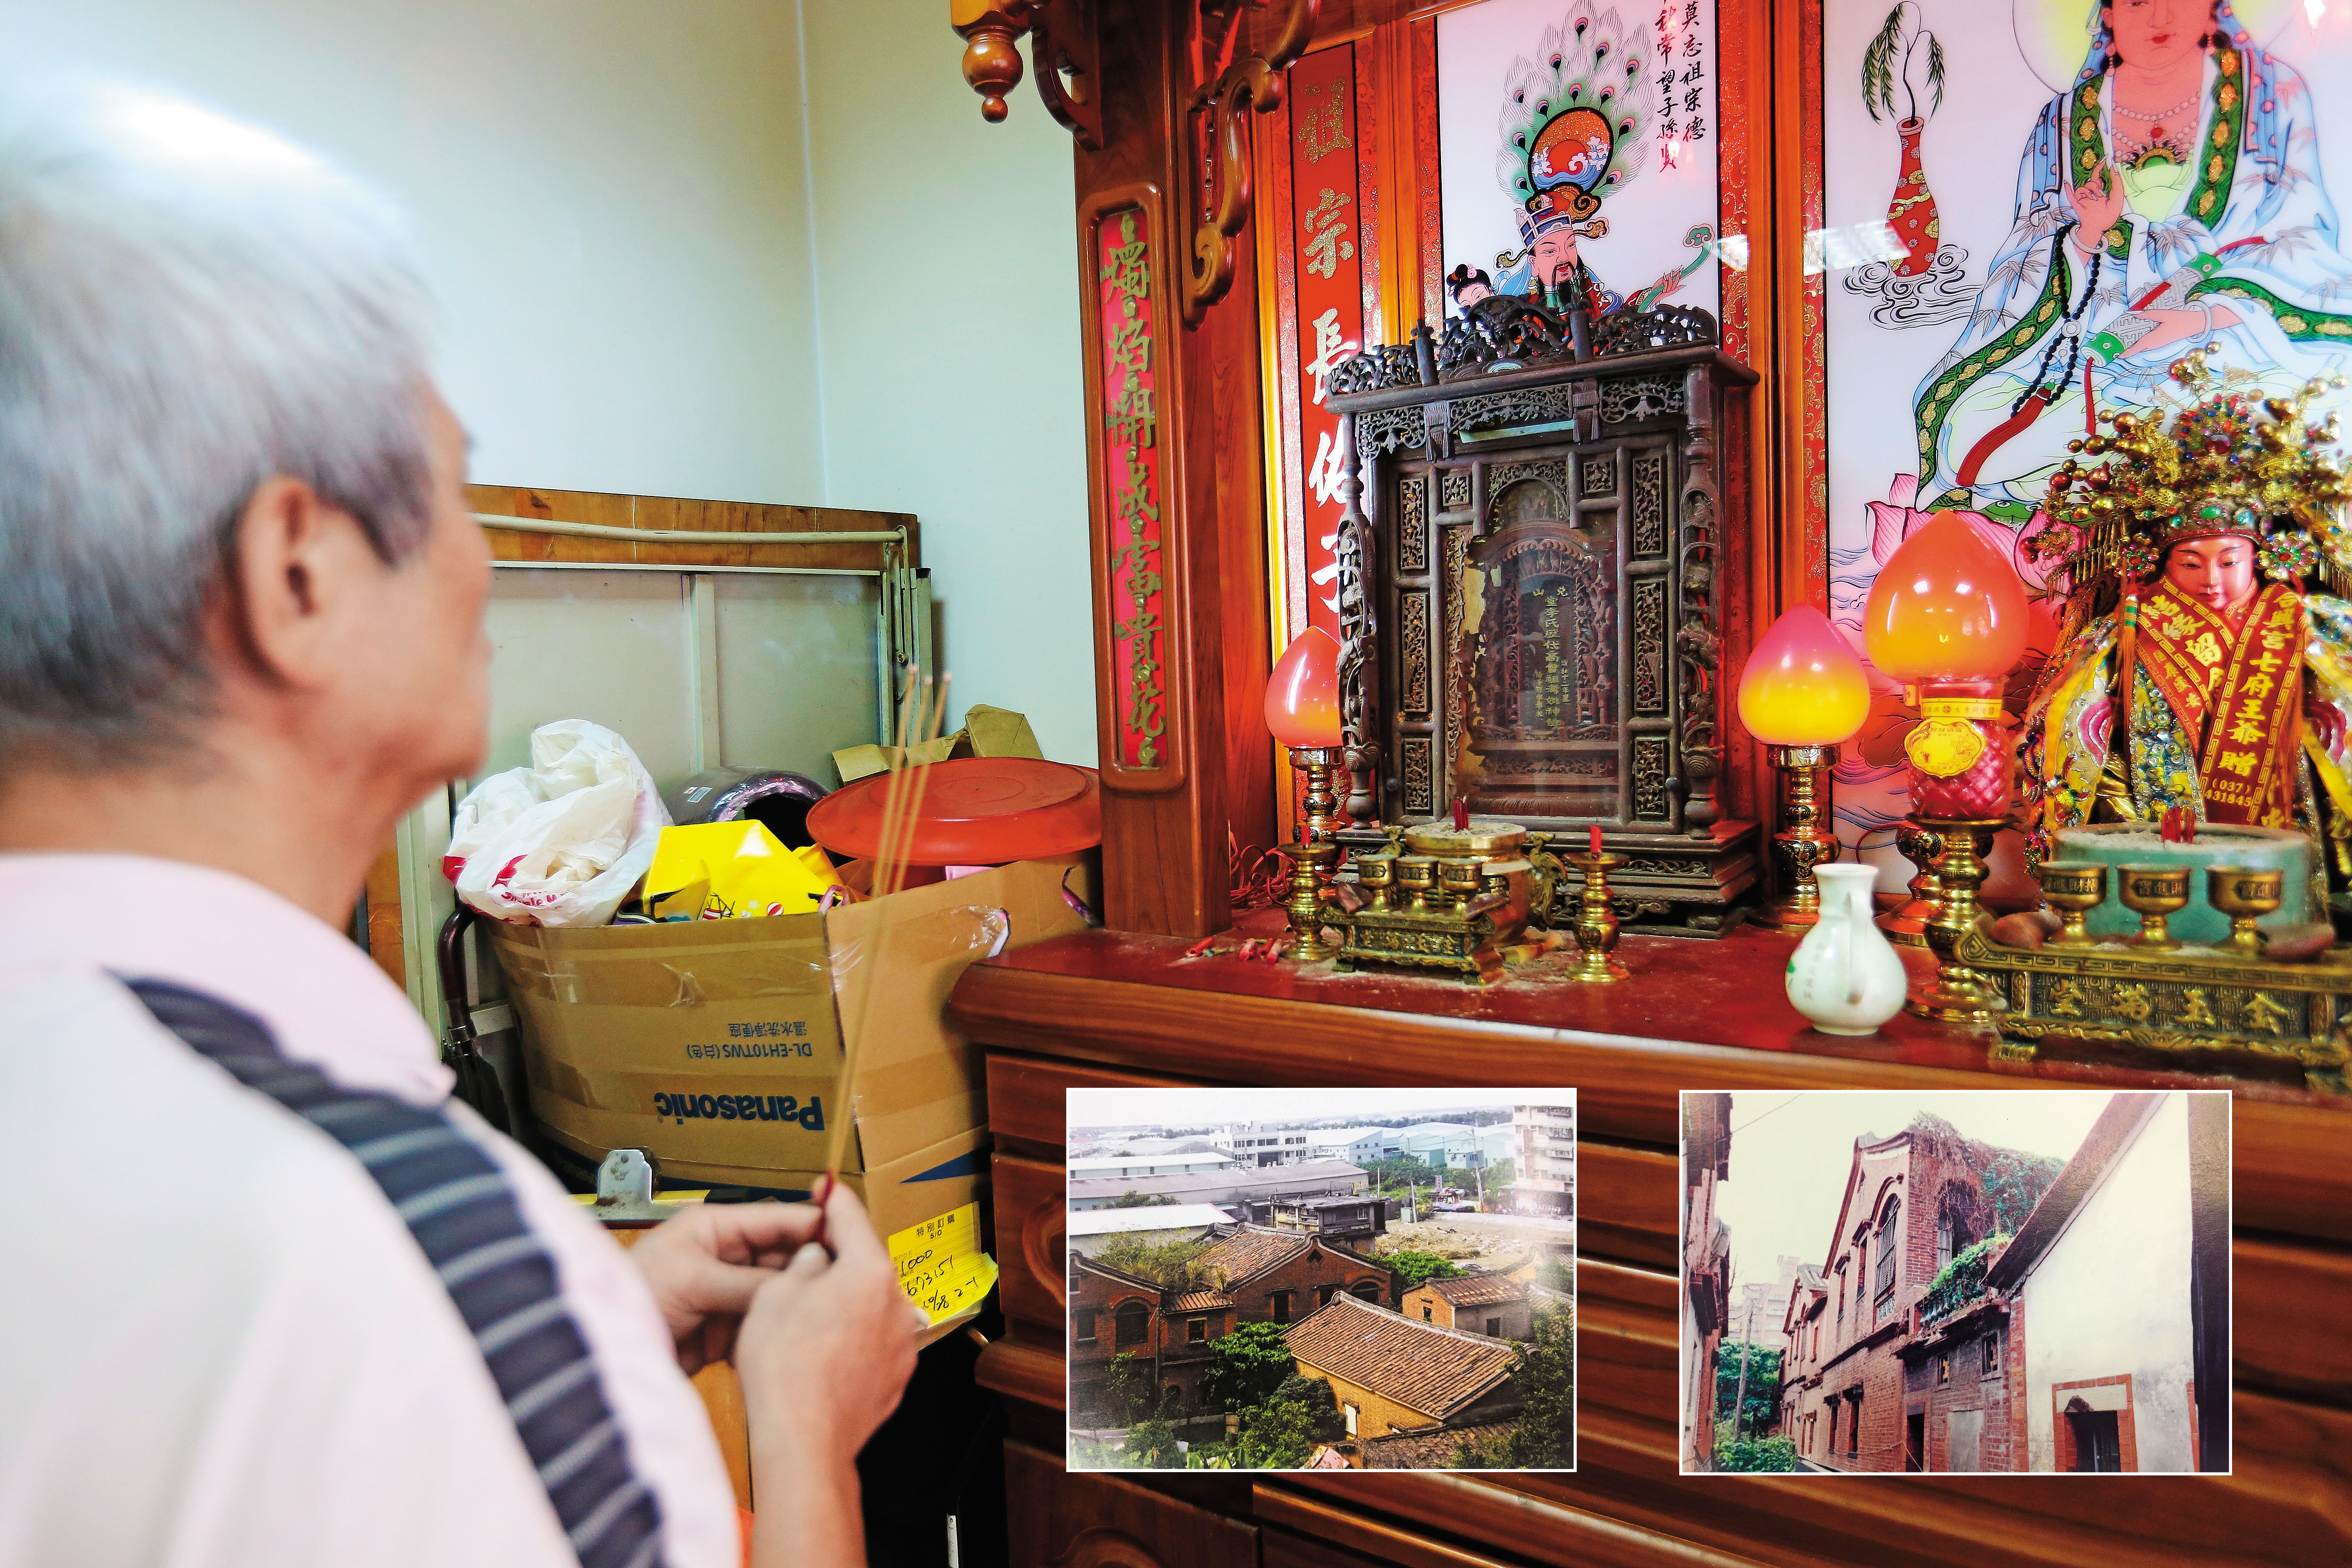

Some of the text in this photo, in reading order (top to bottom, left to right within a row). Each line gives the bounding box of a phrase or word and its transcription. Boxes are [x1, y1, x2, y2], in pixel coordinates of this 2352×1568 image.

[1679, 1, 1706, 142] 莫忘祖宗德
[1655, 0, 1678, 173] 常望子孫賢
[2212, 778, 2250, 794] (037)
[2204, 789, 2252, 807] 431845
[654, 1092, 826, 1131] Panasonic
[916, 1214, 955, 1237] 特別訂購
[930, 1230, 942, 1239] S/O
